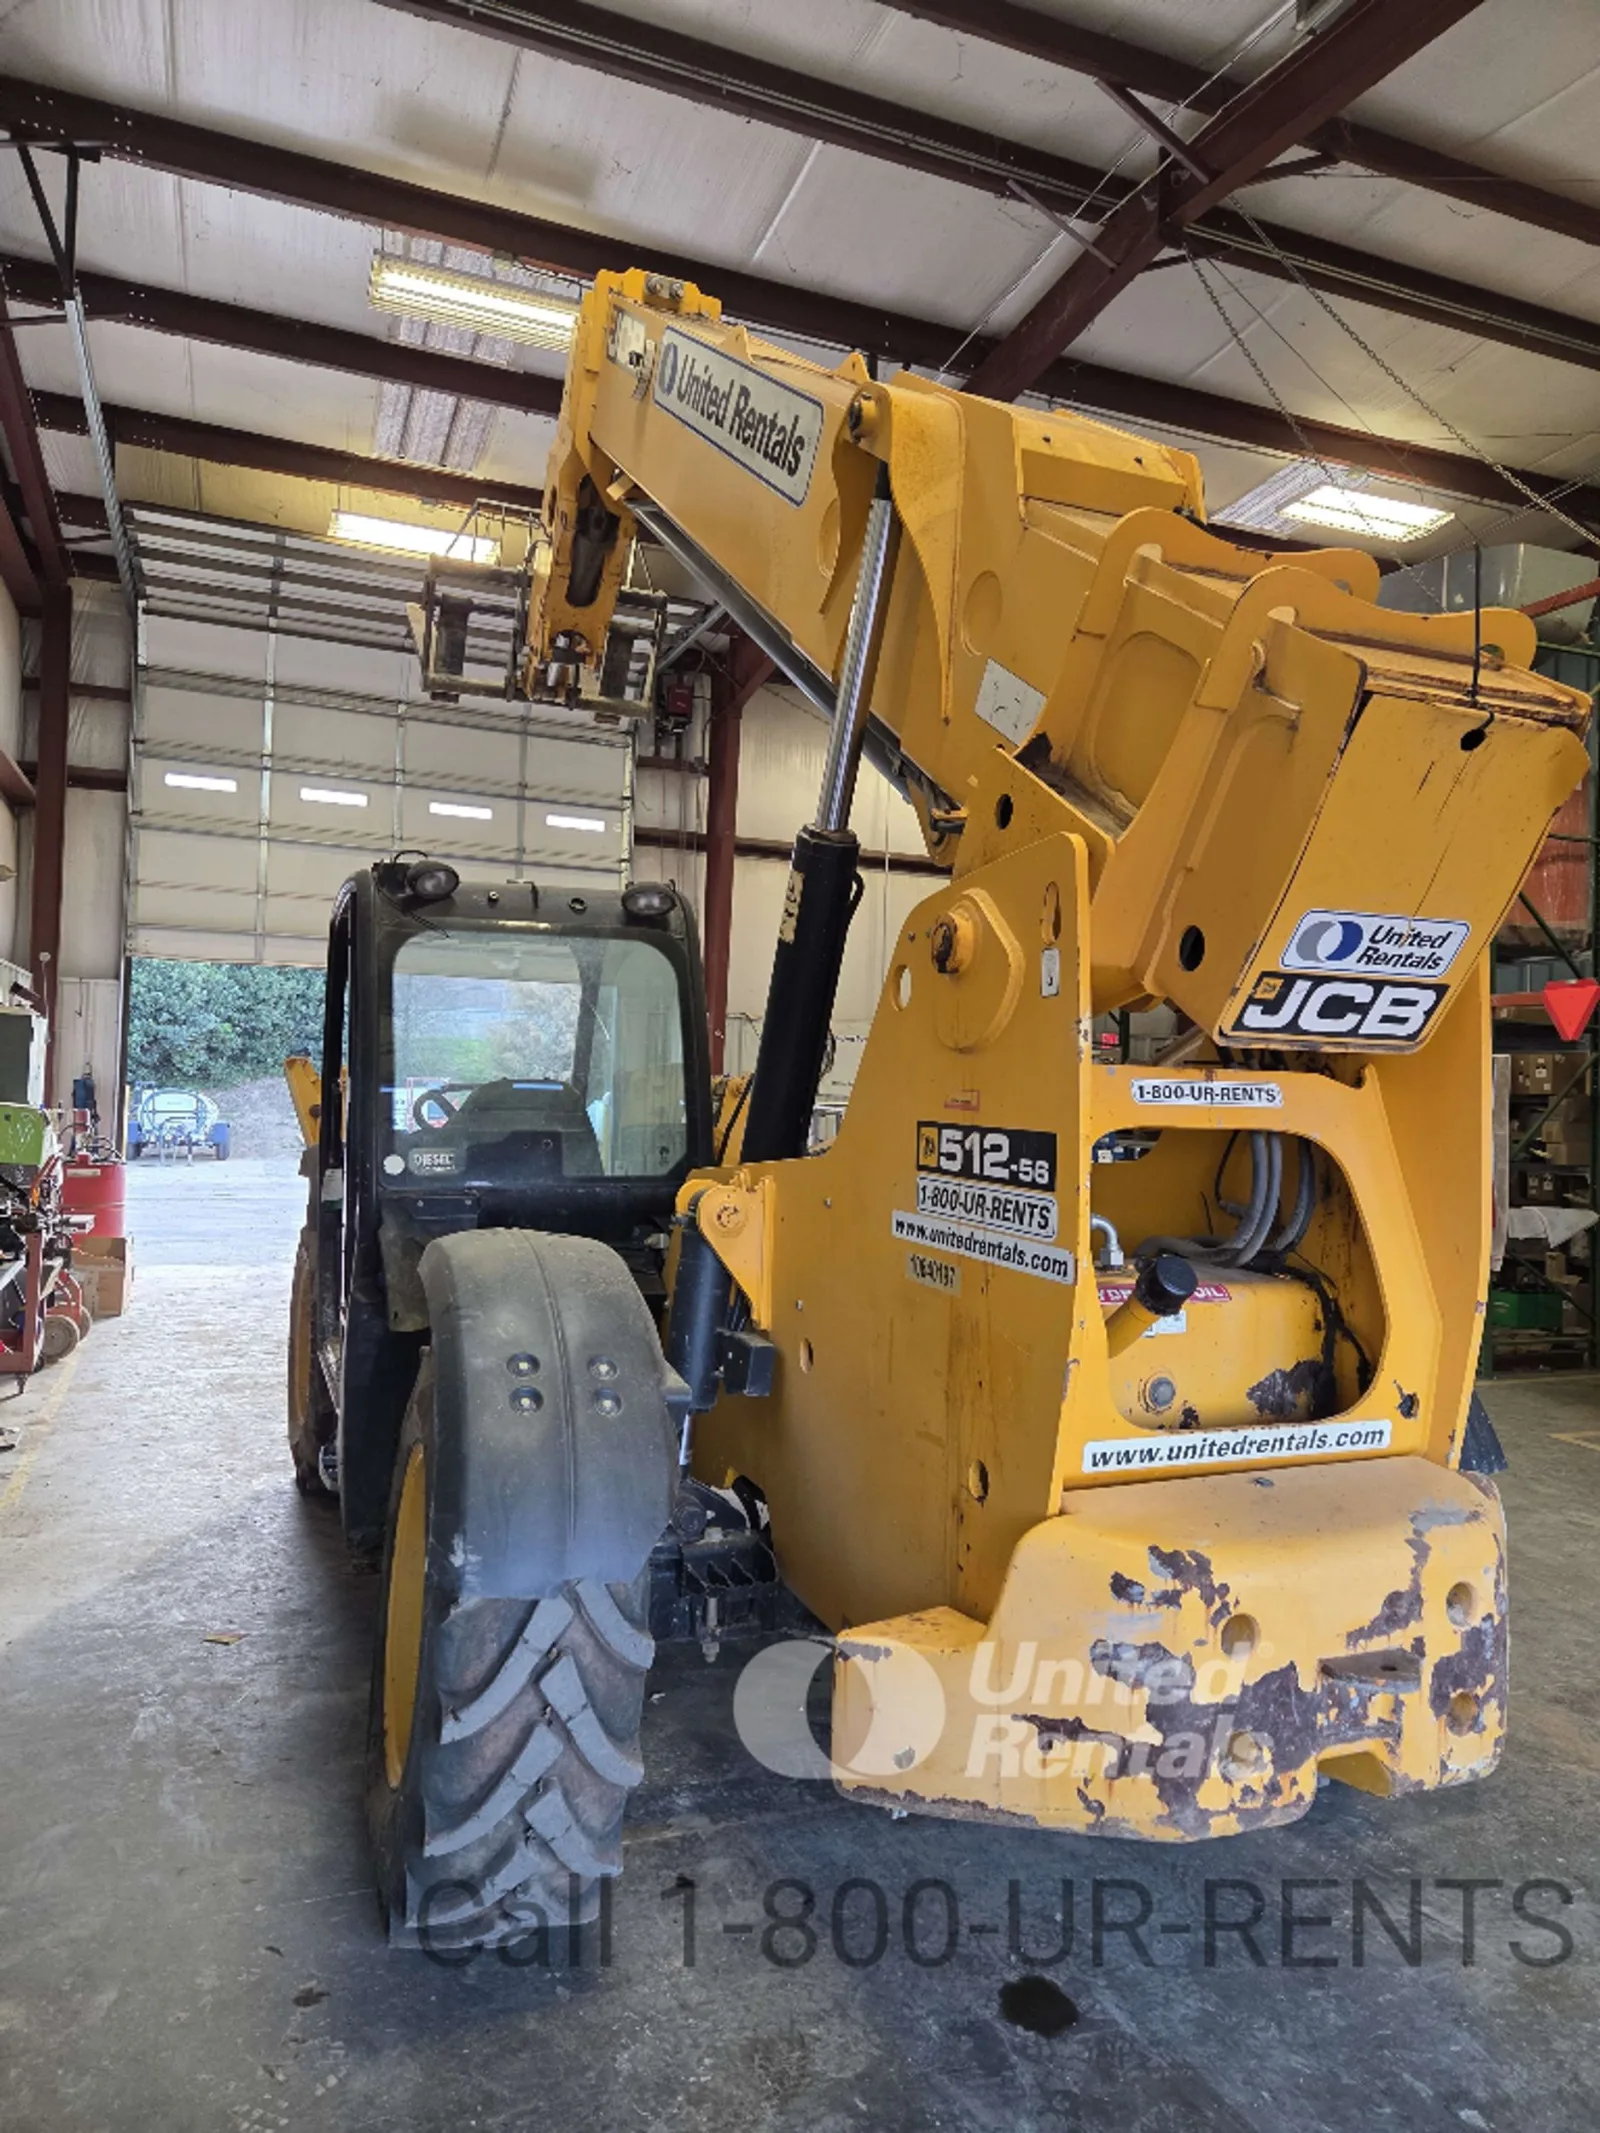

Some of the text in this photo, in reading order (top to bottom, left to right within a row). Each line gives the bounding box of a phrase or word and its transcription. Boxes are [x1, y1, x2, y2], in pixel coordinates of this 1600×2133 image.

[676, 353, 806, 478] United Rentals
[1356, 946, 1445, 970] Rentals
[1369, 924, 1453, 949] United
[1242, 979, 1437, 1036] JCB
[1137, 1084, 1277, 1103] 1-800-UR-RENTS
[939, 1128, 1049, 1184] 512-56
[919, 1185, 1050, 1230] 1-800-UR-RENTS
[895, 1217, 1069, 1278] www.unitedrentals.com
[1091, 1427, 1385, 1468] www.unitedrentals.com
